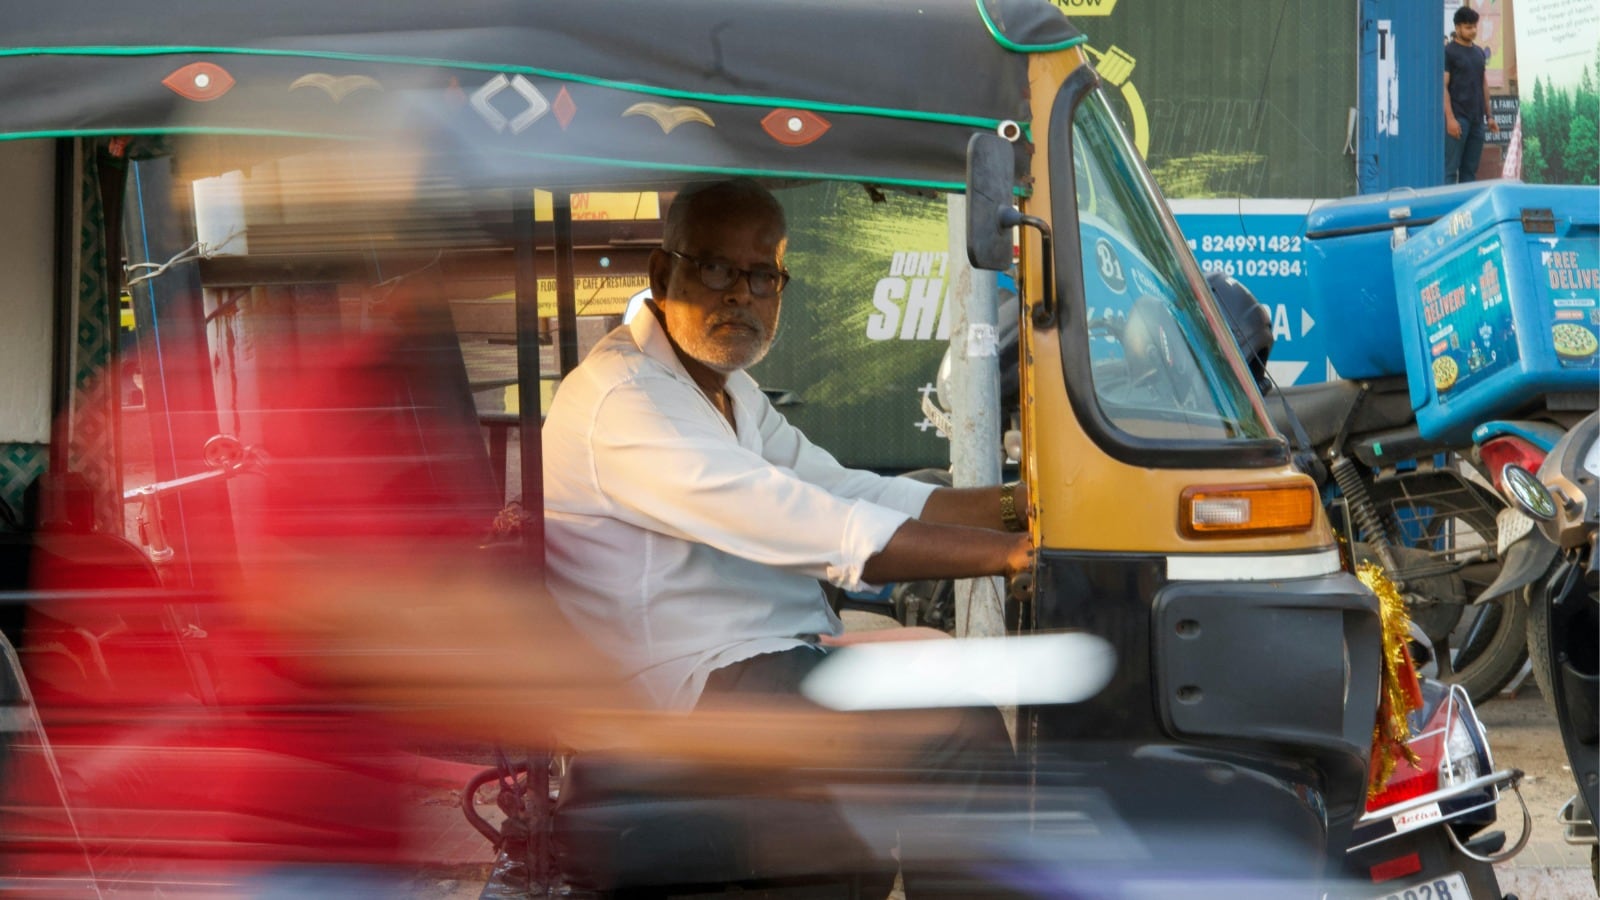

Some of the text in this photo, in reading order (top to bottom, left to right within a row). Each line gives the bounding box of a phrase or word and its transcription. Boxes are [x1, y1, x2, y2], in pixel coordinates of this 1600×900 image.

[1202, 235, 1307, 253] 824991482
[889, 251, 948, 277] DON'T
[1202, 259, 1308, 277] 986102984
[1546, 251, 1579, 269] FREE
[582, 279, 598, 290] CAFE
[606, 275, 649, 289] RESTAURANT
[1421, 280, 1440, 306] FREE
[1425, 285, 1465, 327] DELIVERY
